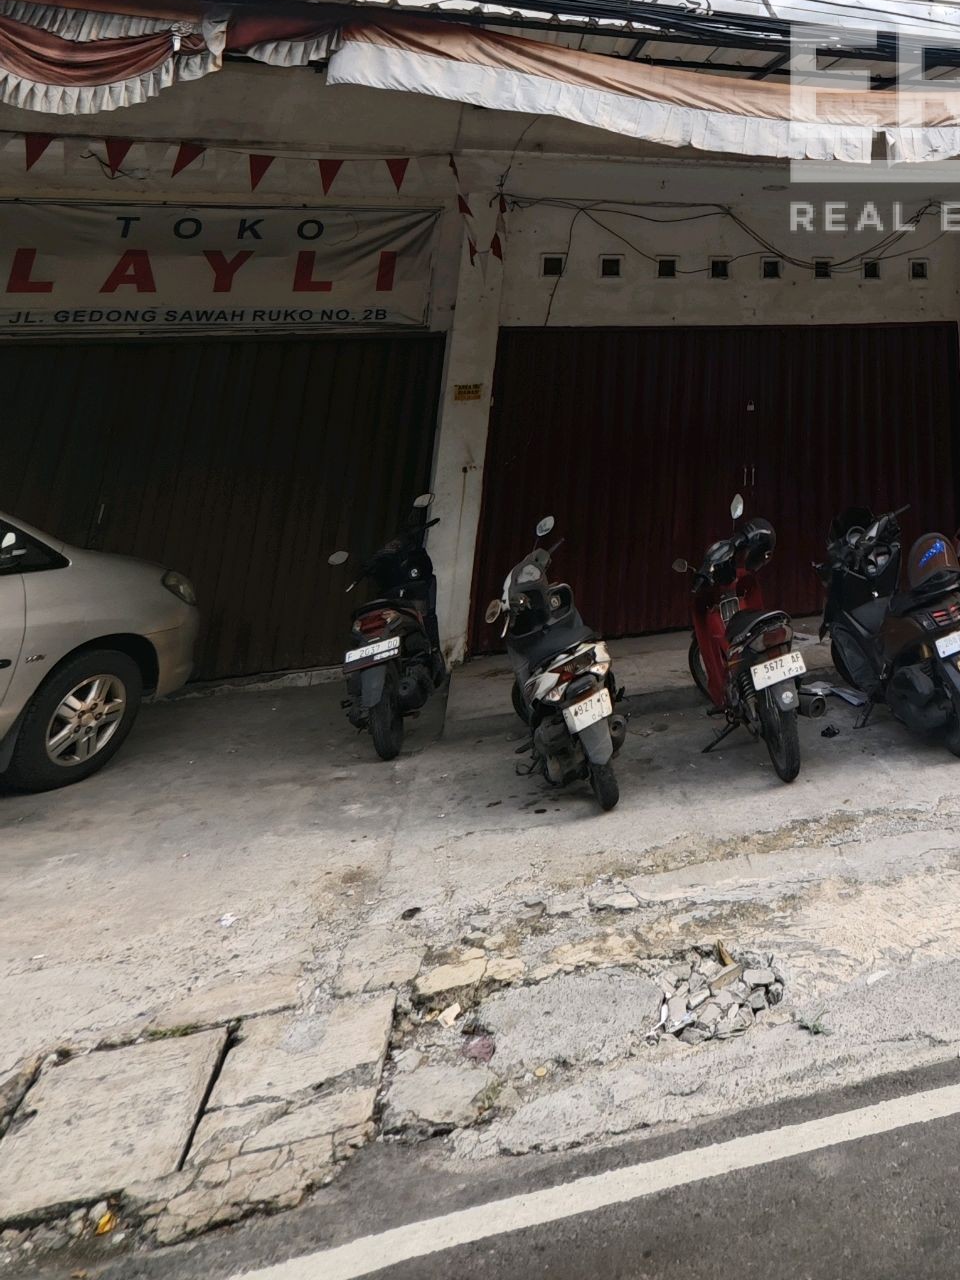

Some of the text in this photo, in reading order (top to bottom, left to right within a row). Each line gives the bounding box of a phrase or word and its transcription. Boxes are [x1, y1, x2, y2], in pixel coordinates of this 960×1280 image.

[115, 216, 325, 240] TOKO
[6, 247, 398, 293] LAYLI
[8, 308, 388, 324] JL. GEDONG SAWAH RUKO NO. 2B
